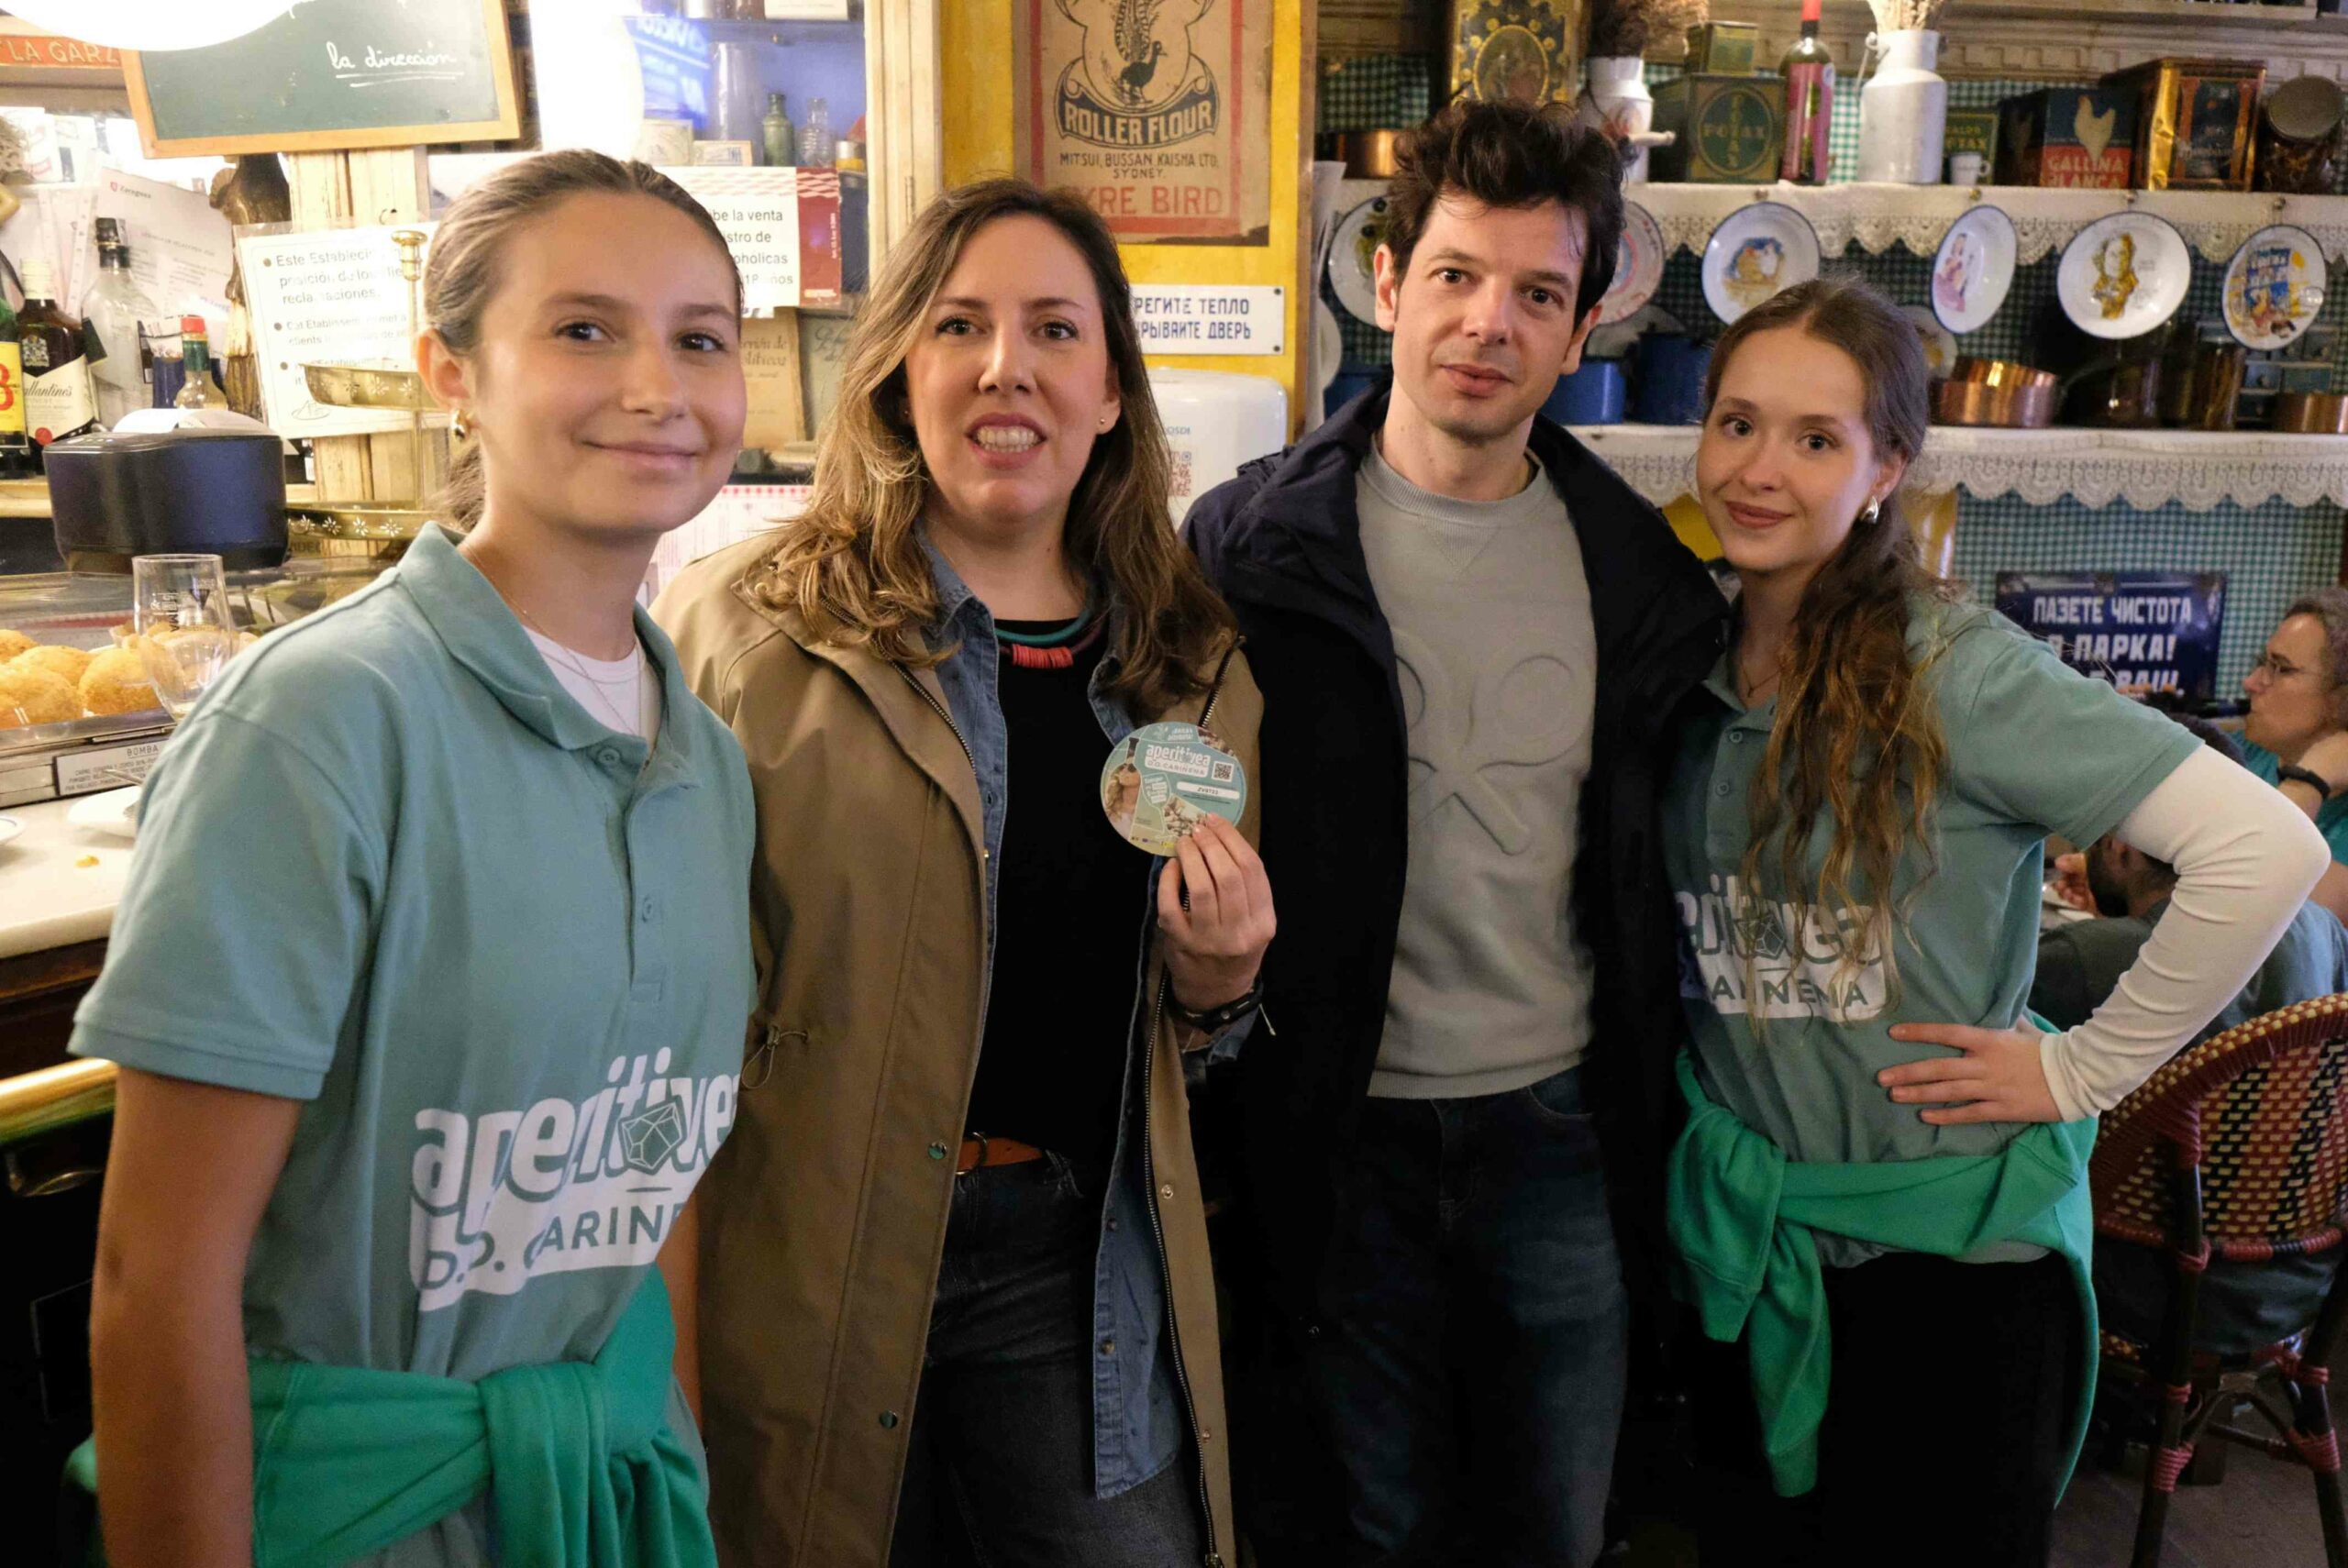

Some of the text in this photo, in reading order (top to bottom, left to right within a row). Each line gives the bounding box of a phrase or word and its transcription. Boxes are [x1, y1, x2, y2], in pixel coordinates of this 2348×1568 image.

[7, 40, 41, 62] LA
[326, 40, 459, 70] la dirección
[1063, 99, 1213, 145] ROLLER FLOUR
[1105, 153, 1153, 167] BUSSAN
[2047, 155, 2124, 173] GALLINA
[1150, 185, 1224, 216] BIRD
[708, 209, 783, 222] be la venta
[755, 231, 772, 243] de
[276, 253, 305, 268] Este
[1134, 297, 1250, 315] РЕГИТЕ ТЕПЛО
[1207, 321, 1252, 340] ДВЕРЬ
[24, 381, 72, 398] allantine's
[2032, 596, 2192, 624] ПАЗЕТЕ ЧИСТОТА
[2073, 634, 2177, 661] ПАРКА!
[127, 744, 160, 756] BOMBA
[1146, 744, 1211, 768] aperitivea
